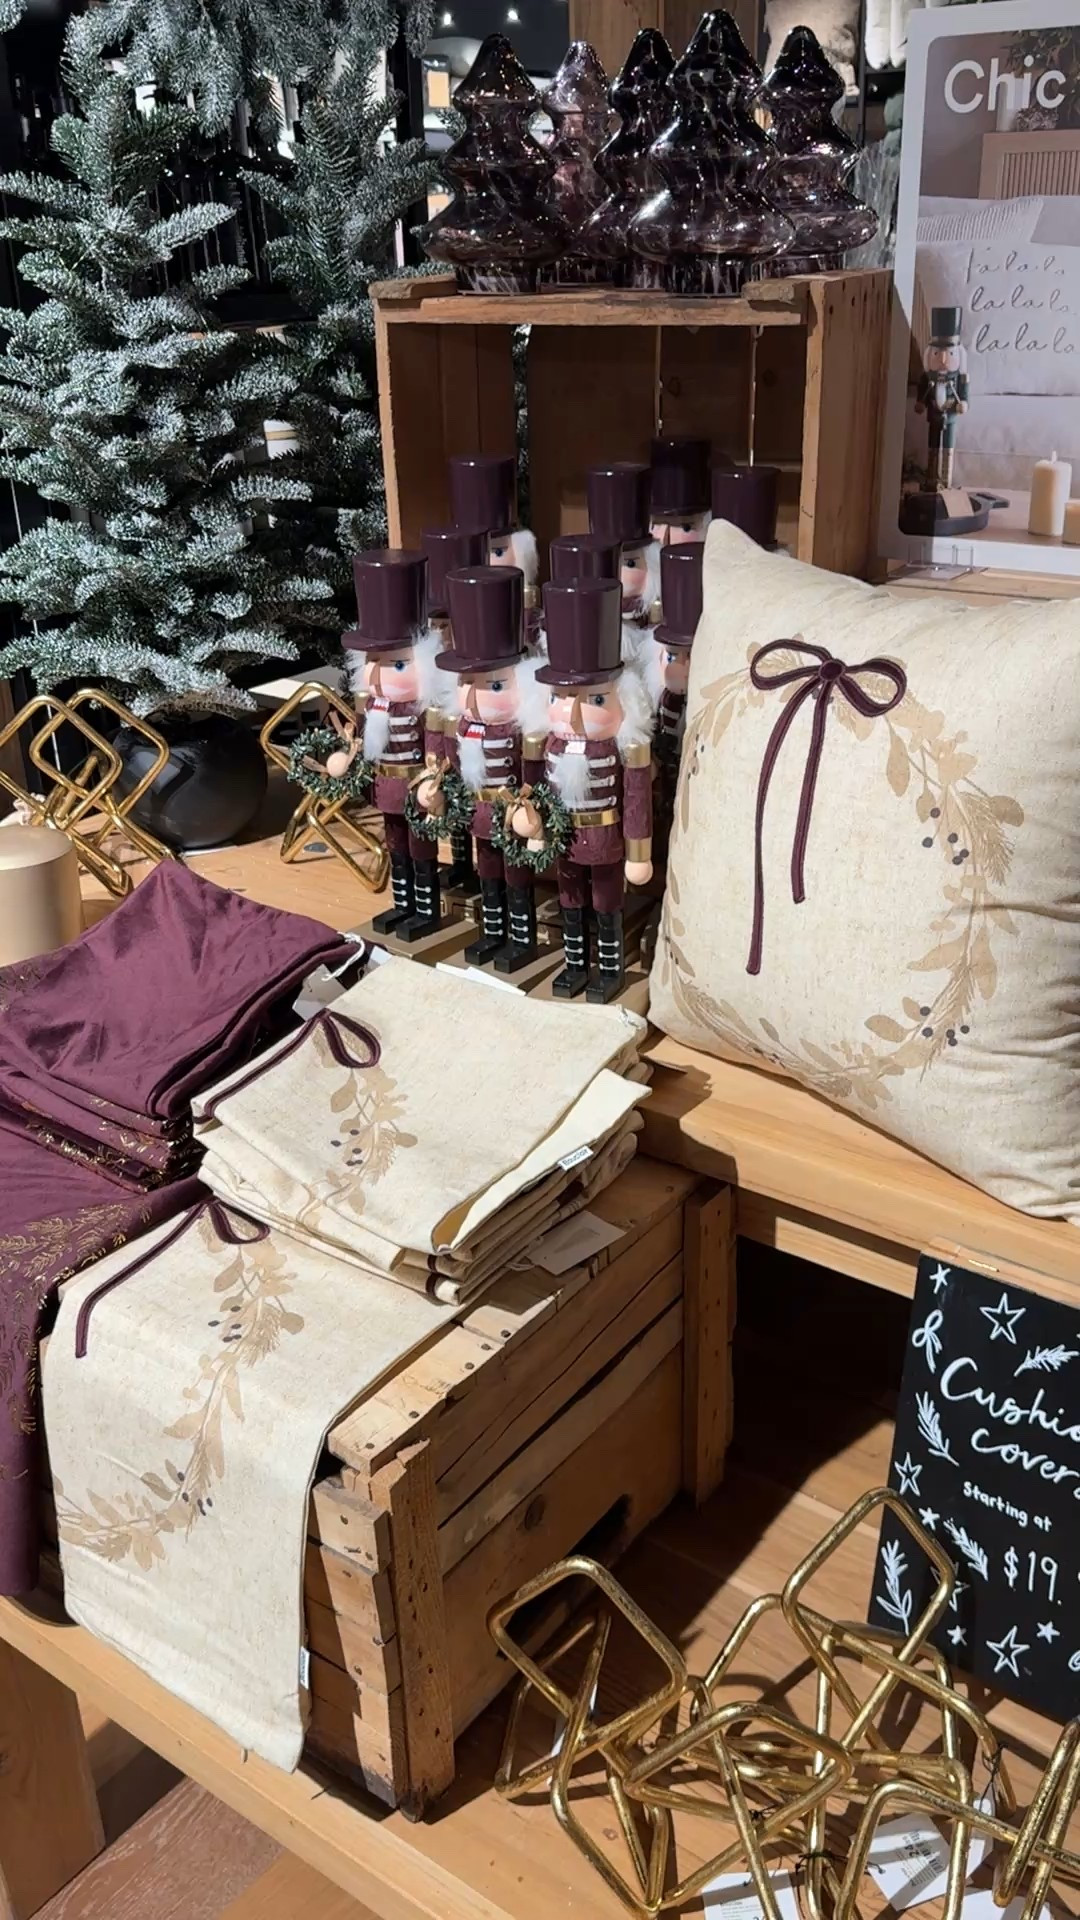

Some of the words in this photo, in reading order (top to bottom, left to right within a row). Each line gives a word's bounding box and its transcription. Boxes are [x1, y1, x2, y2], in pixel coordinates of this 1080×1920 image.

[944, 54, 1067, 113] Chic
[971, 285, 1005, 313] la
[1011, 284, 1044, 309] la
[975, 323, 1010, 354] la
[1014, 322, 1049, 352] la
[1052, 326, 1075, 354] la
[1033, 1515, 1052, 1532] at
